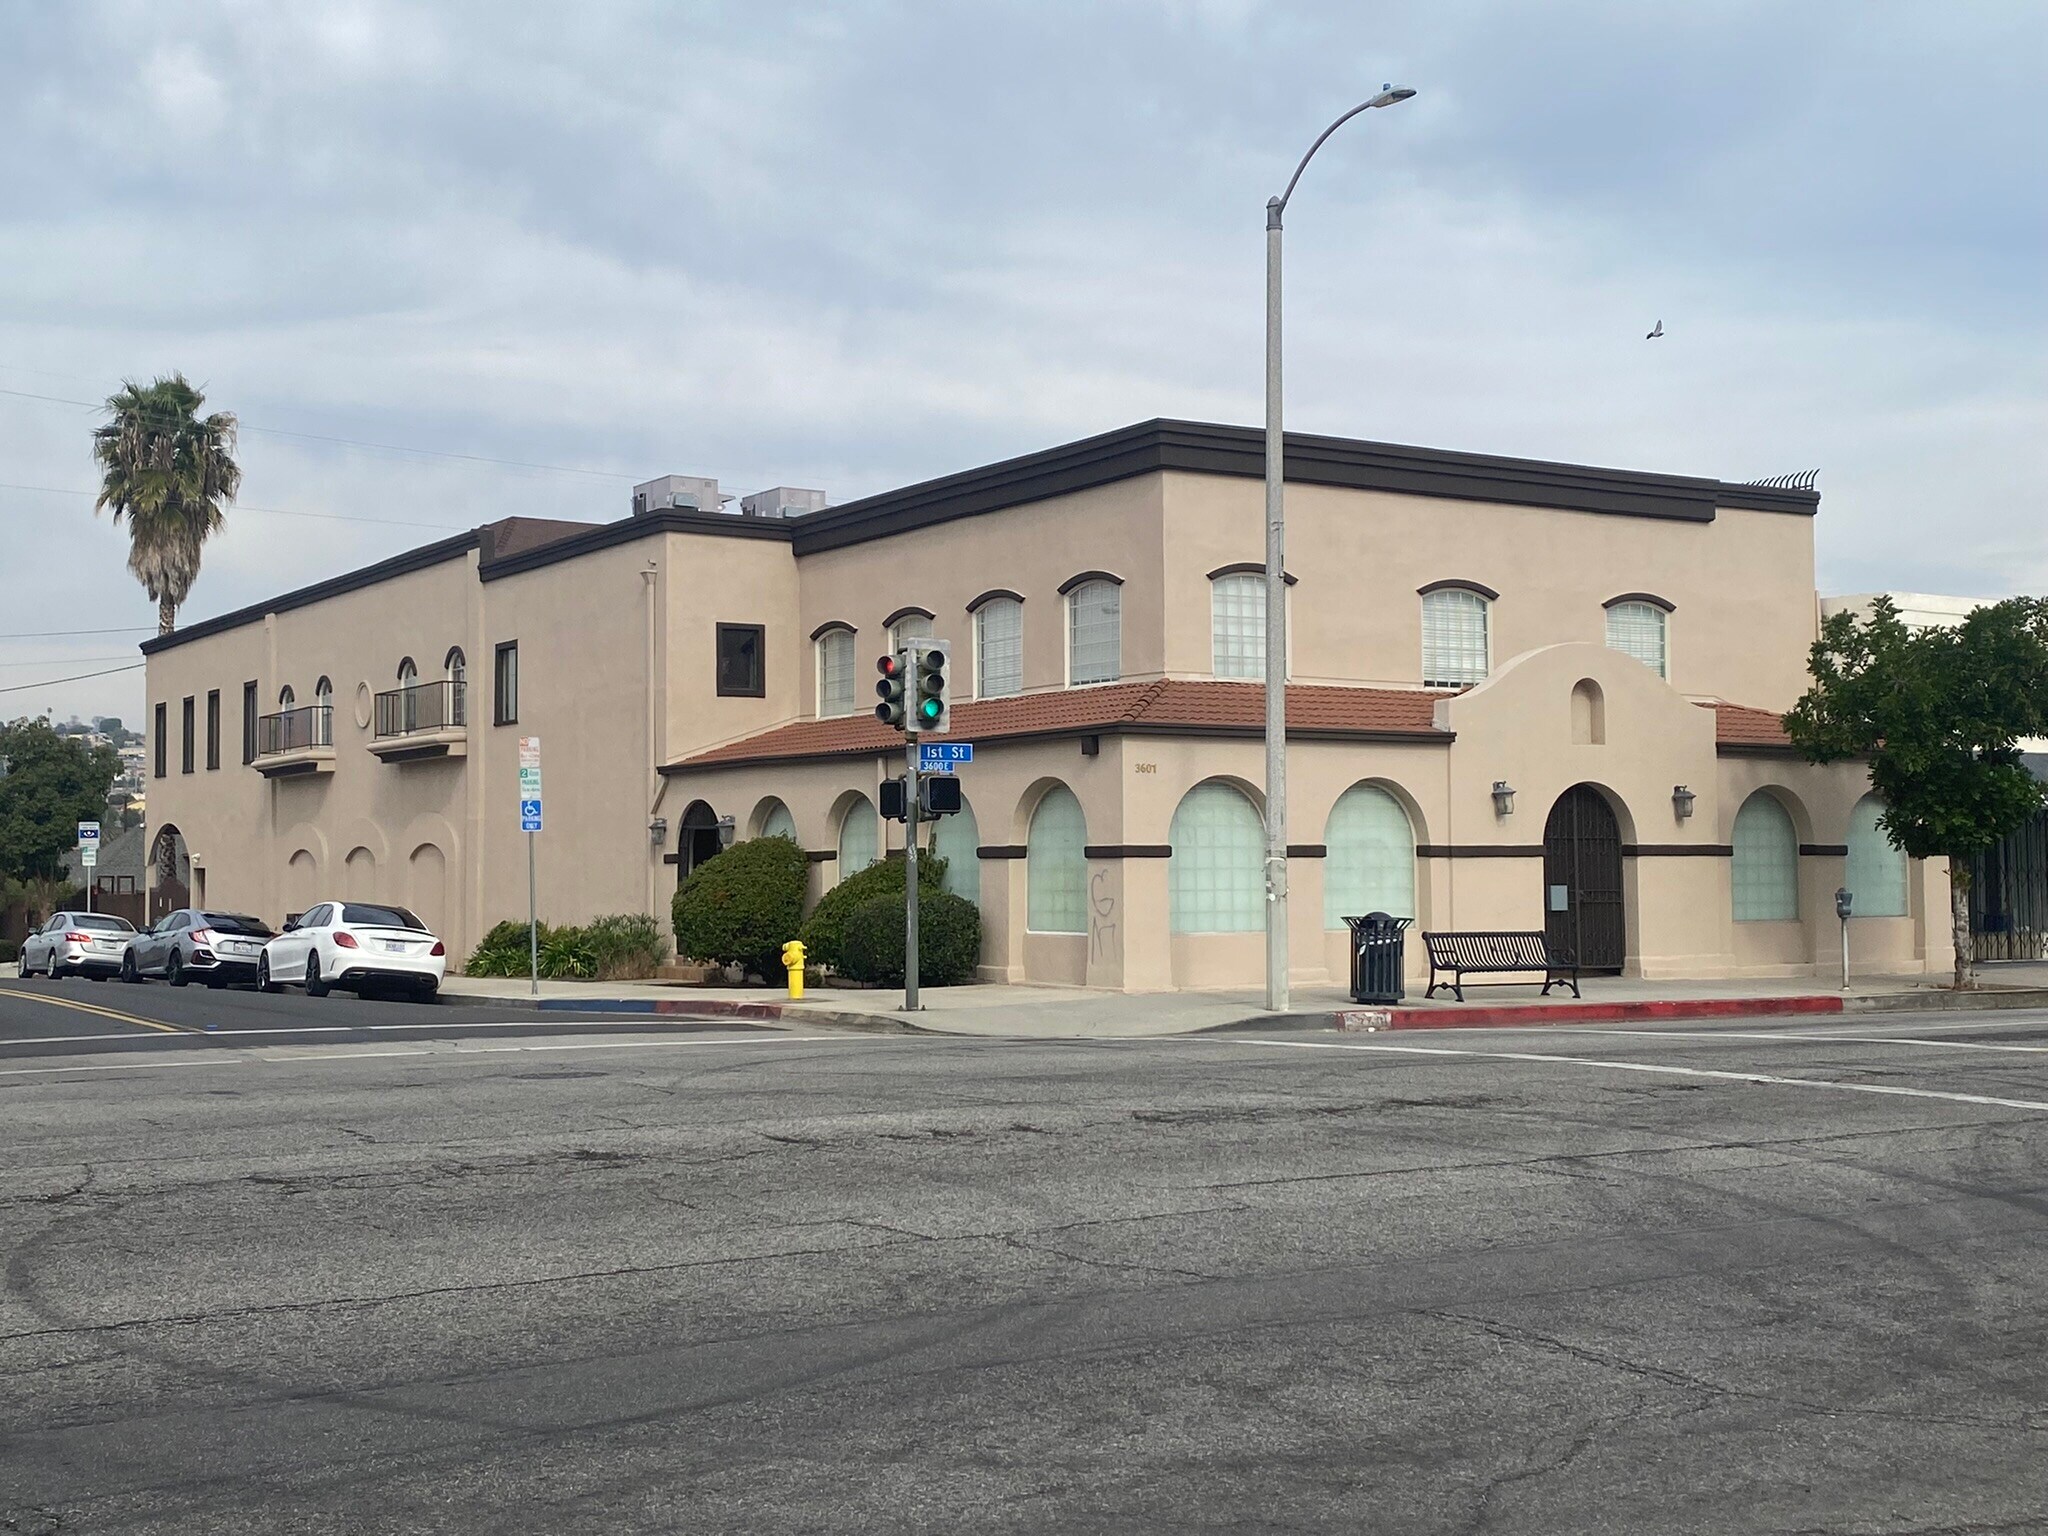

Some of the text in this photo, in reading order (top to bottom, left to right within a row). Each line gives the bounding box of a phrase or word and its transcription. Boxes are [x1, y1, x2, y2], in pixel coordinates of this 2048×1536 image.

[927, 746, 964, 758] 1st St
[521, 769, 527, 777] 2
[1135, 763, 1157, 774] 3601
